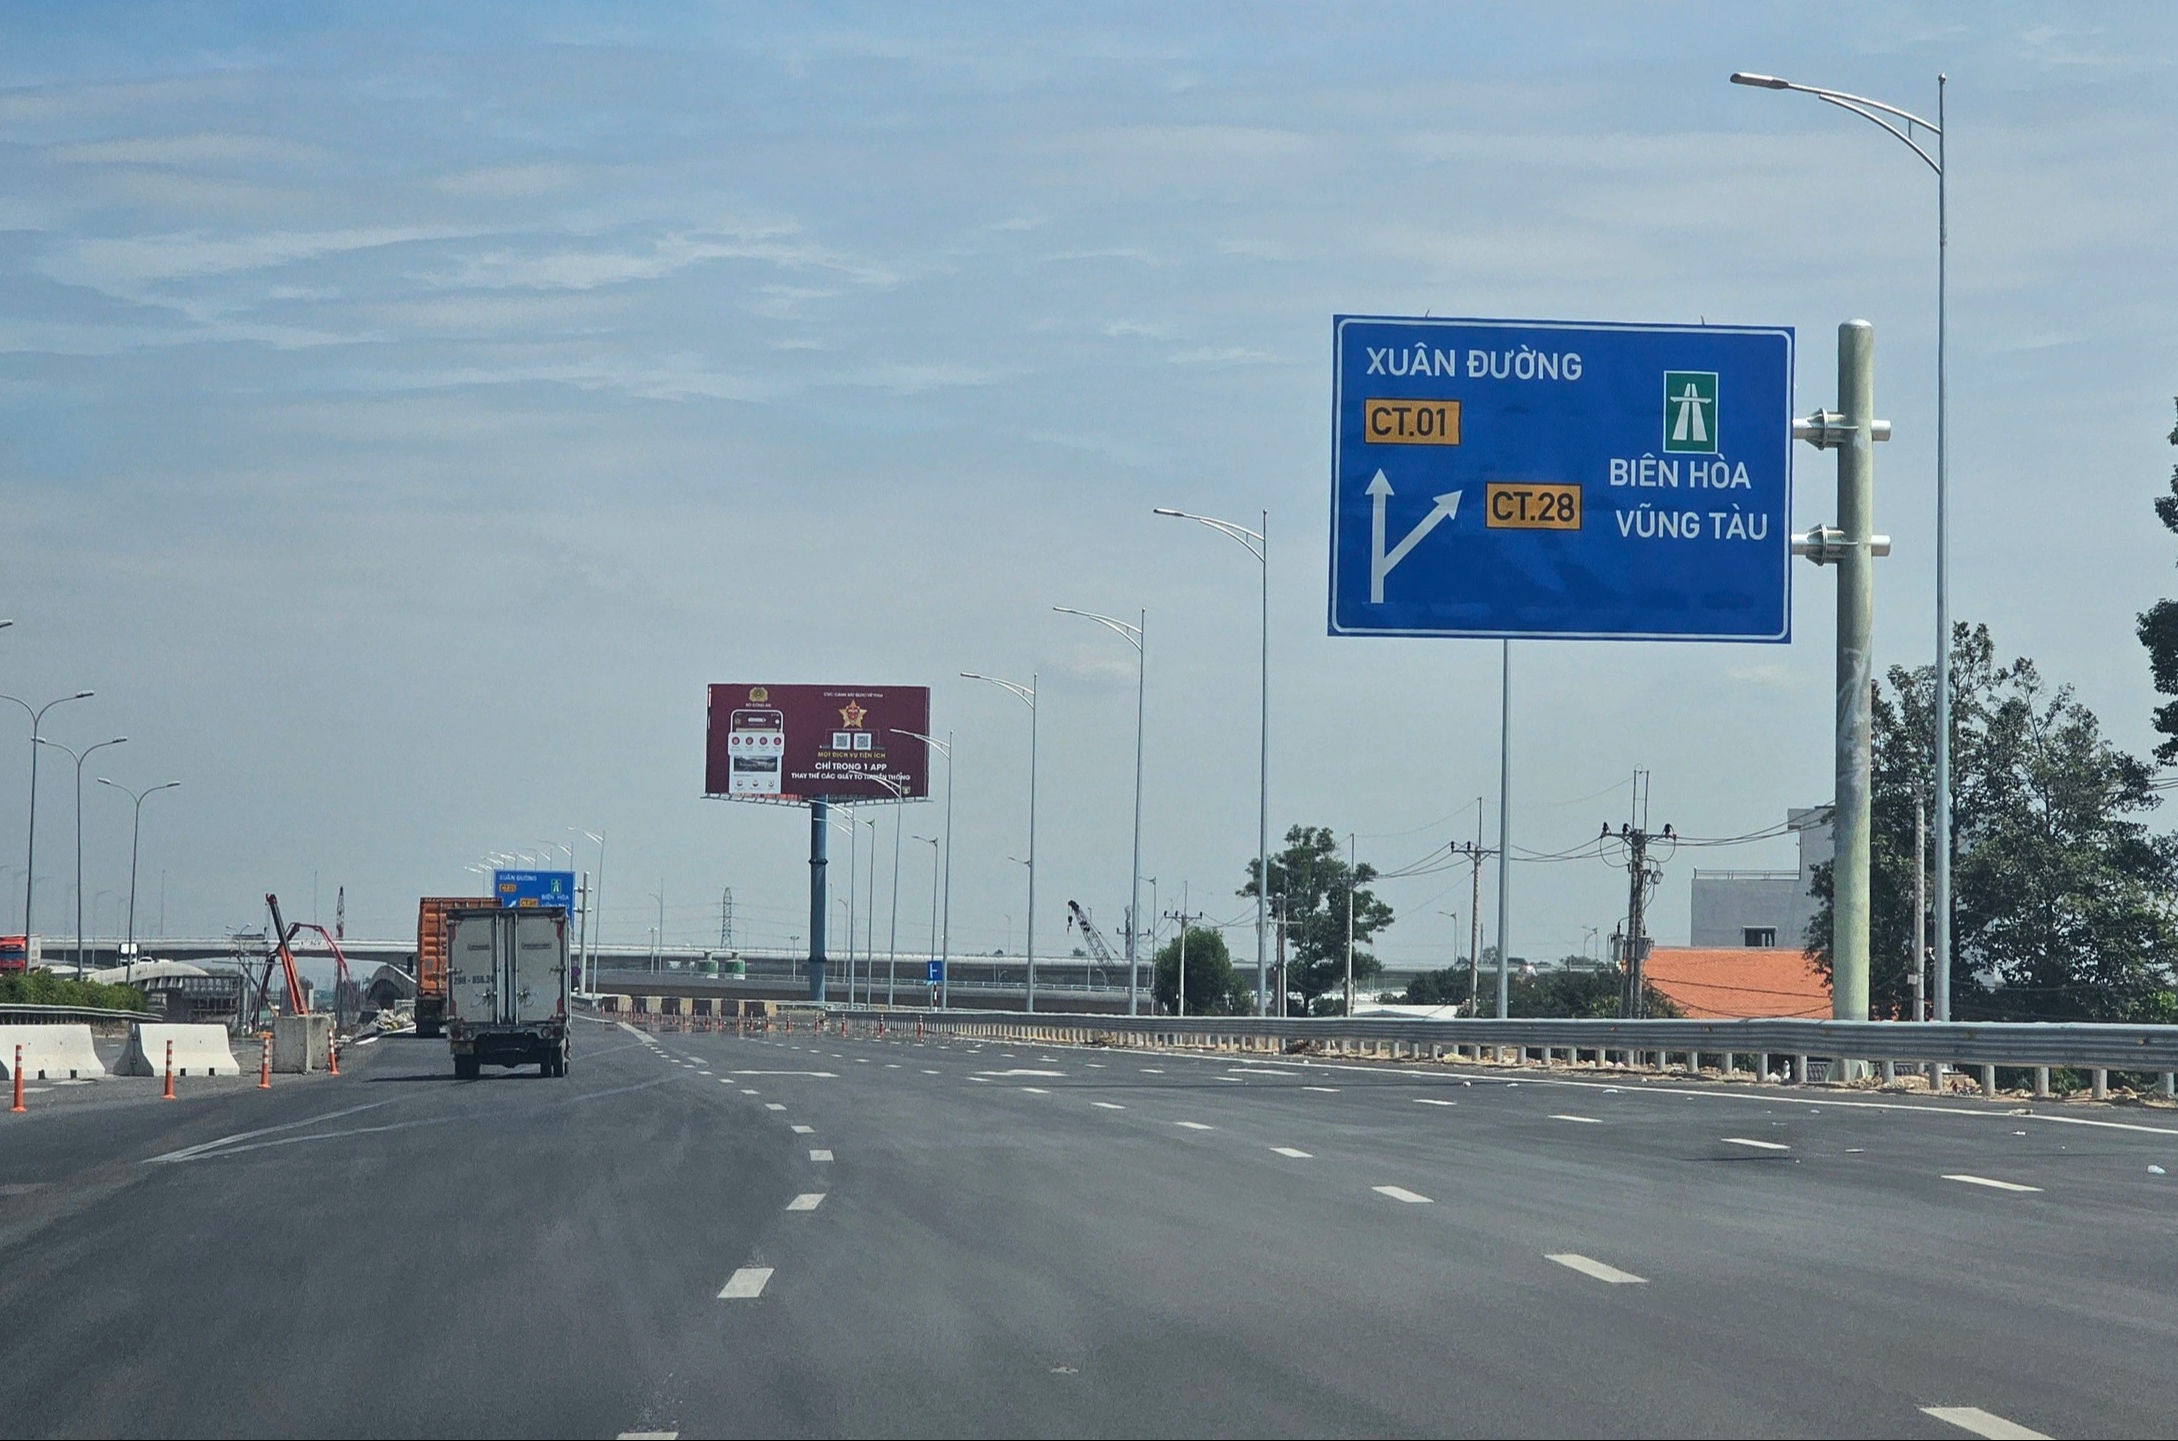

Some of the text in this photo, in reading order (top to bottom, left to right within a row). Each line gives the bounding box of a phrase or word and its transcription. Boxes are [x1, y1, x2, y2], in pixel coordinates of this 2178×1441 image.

[1366, 342, 1583, 381] XUÂN ĐƯỜNG
[1371, 407, 1446, 437] CT.01
[1609, 452, 1752, 489] BIÊN HÒA
[1492, 491, 1575, 522] CT.28
[1615, 502, 1768, 540] VŨNG TÀU
[791, 772, 808, 780] THAY
[821, 772, 836, 780] CÁC
[832, 762, 862, 771] TRONG
[864, 763, 868, 771] 1
[870, 763, 889, 772] APP
